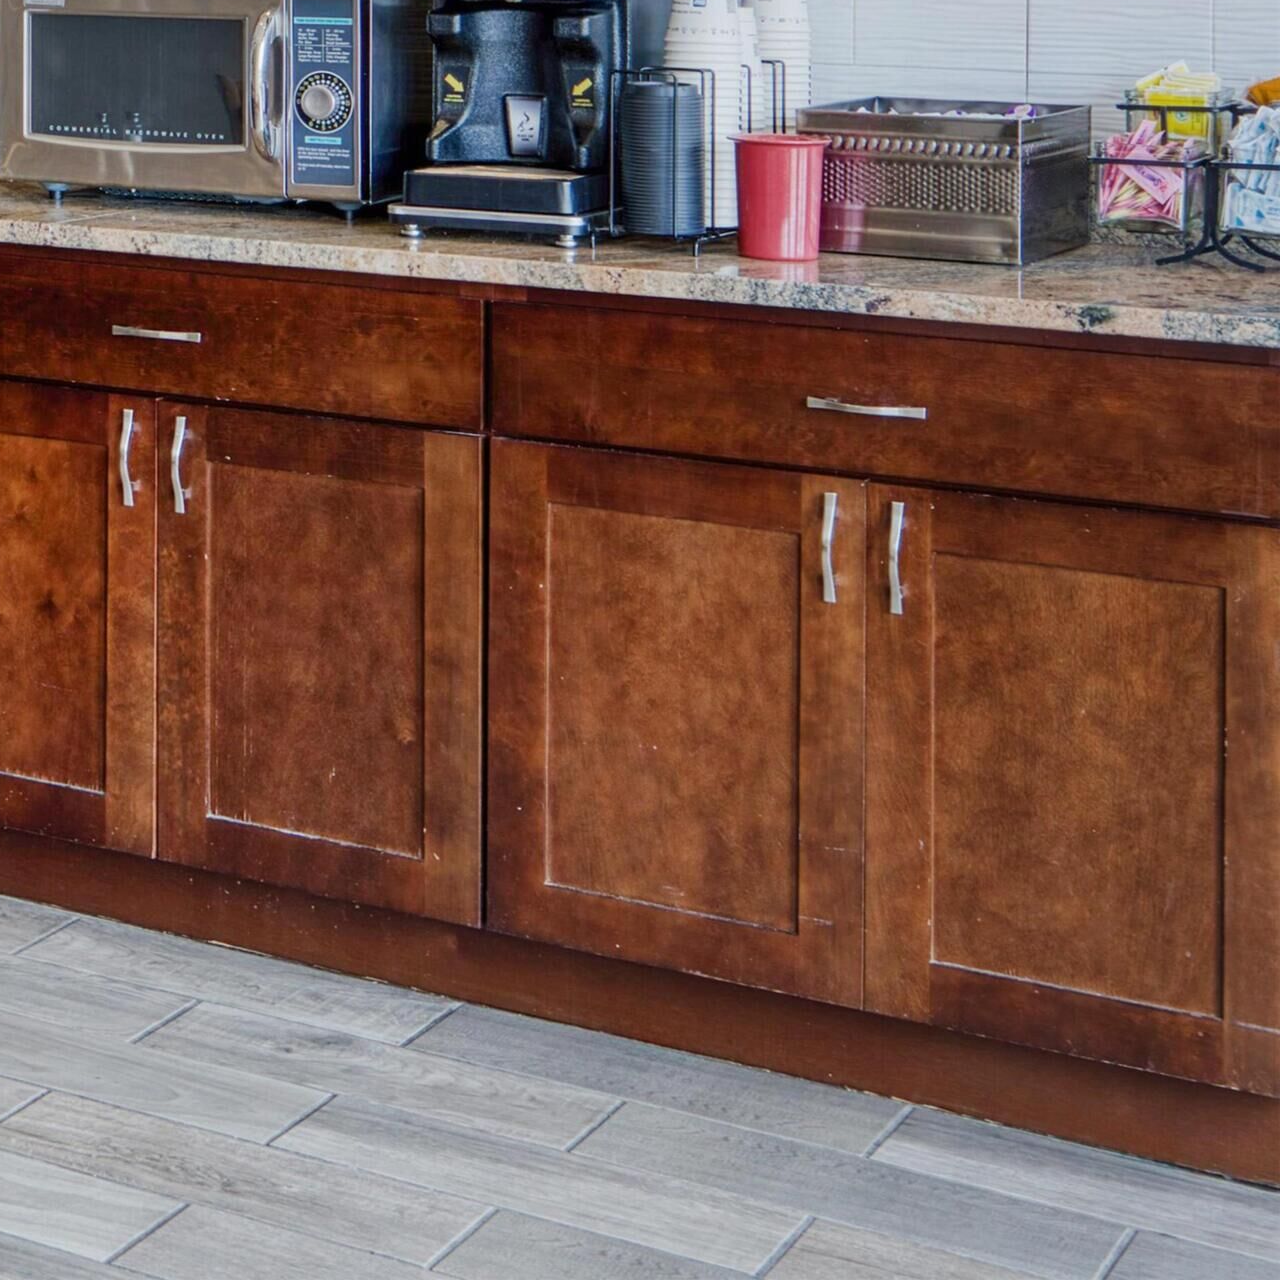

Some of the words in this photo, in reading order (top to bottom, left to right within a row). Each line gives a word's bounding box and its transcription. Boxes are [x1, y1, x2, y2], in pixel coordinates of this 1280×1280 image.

[48, 124, 117, 135] COMMERCIAL
[125, 128, 188, 139] MICROWAVE
[196, 132, 225, 140] OVEN
